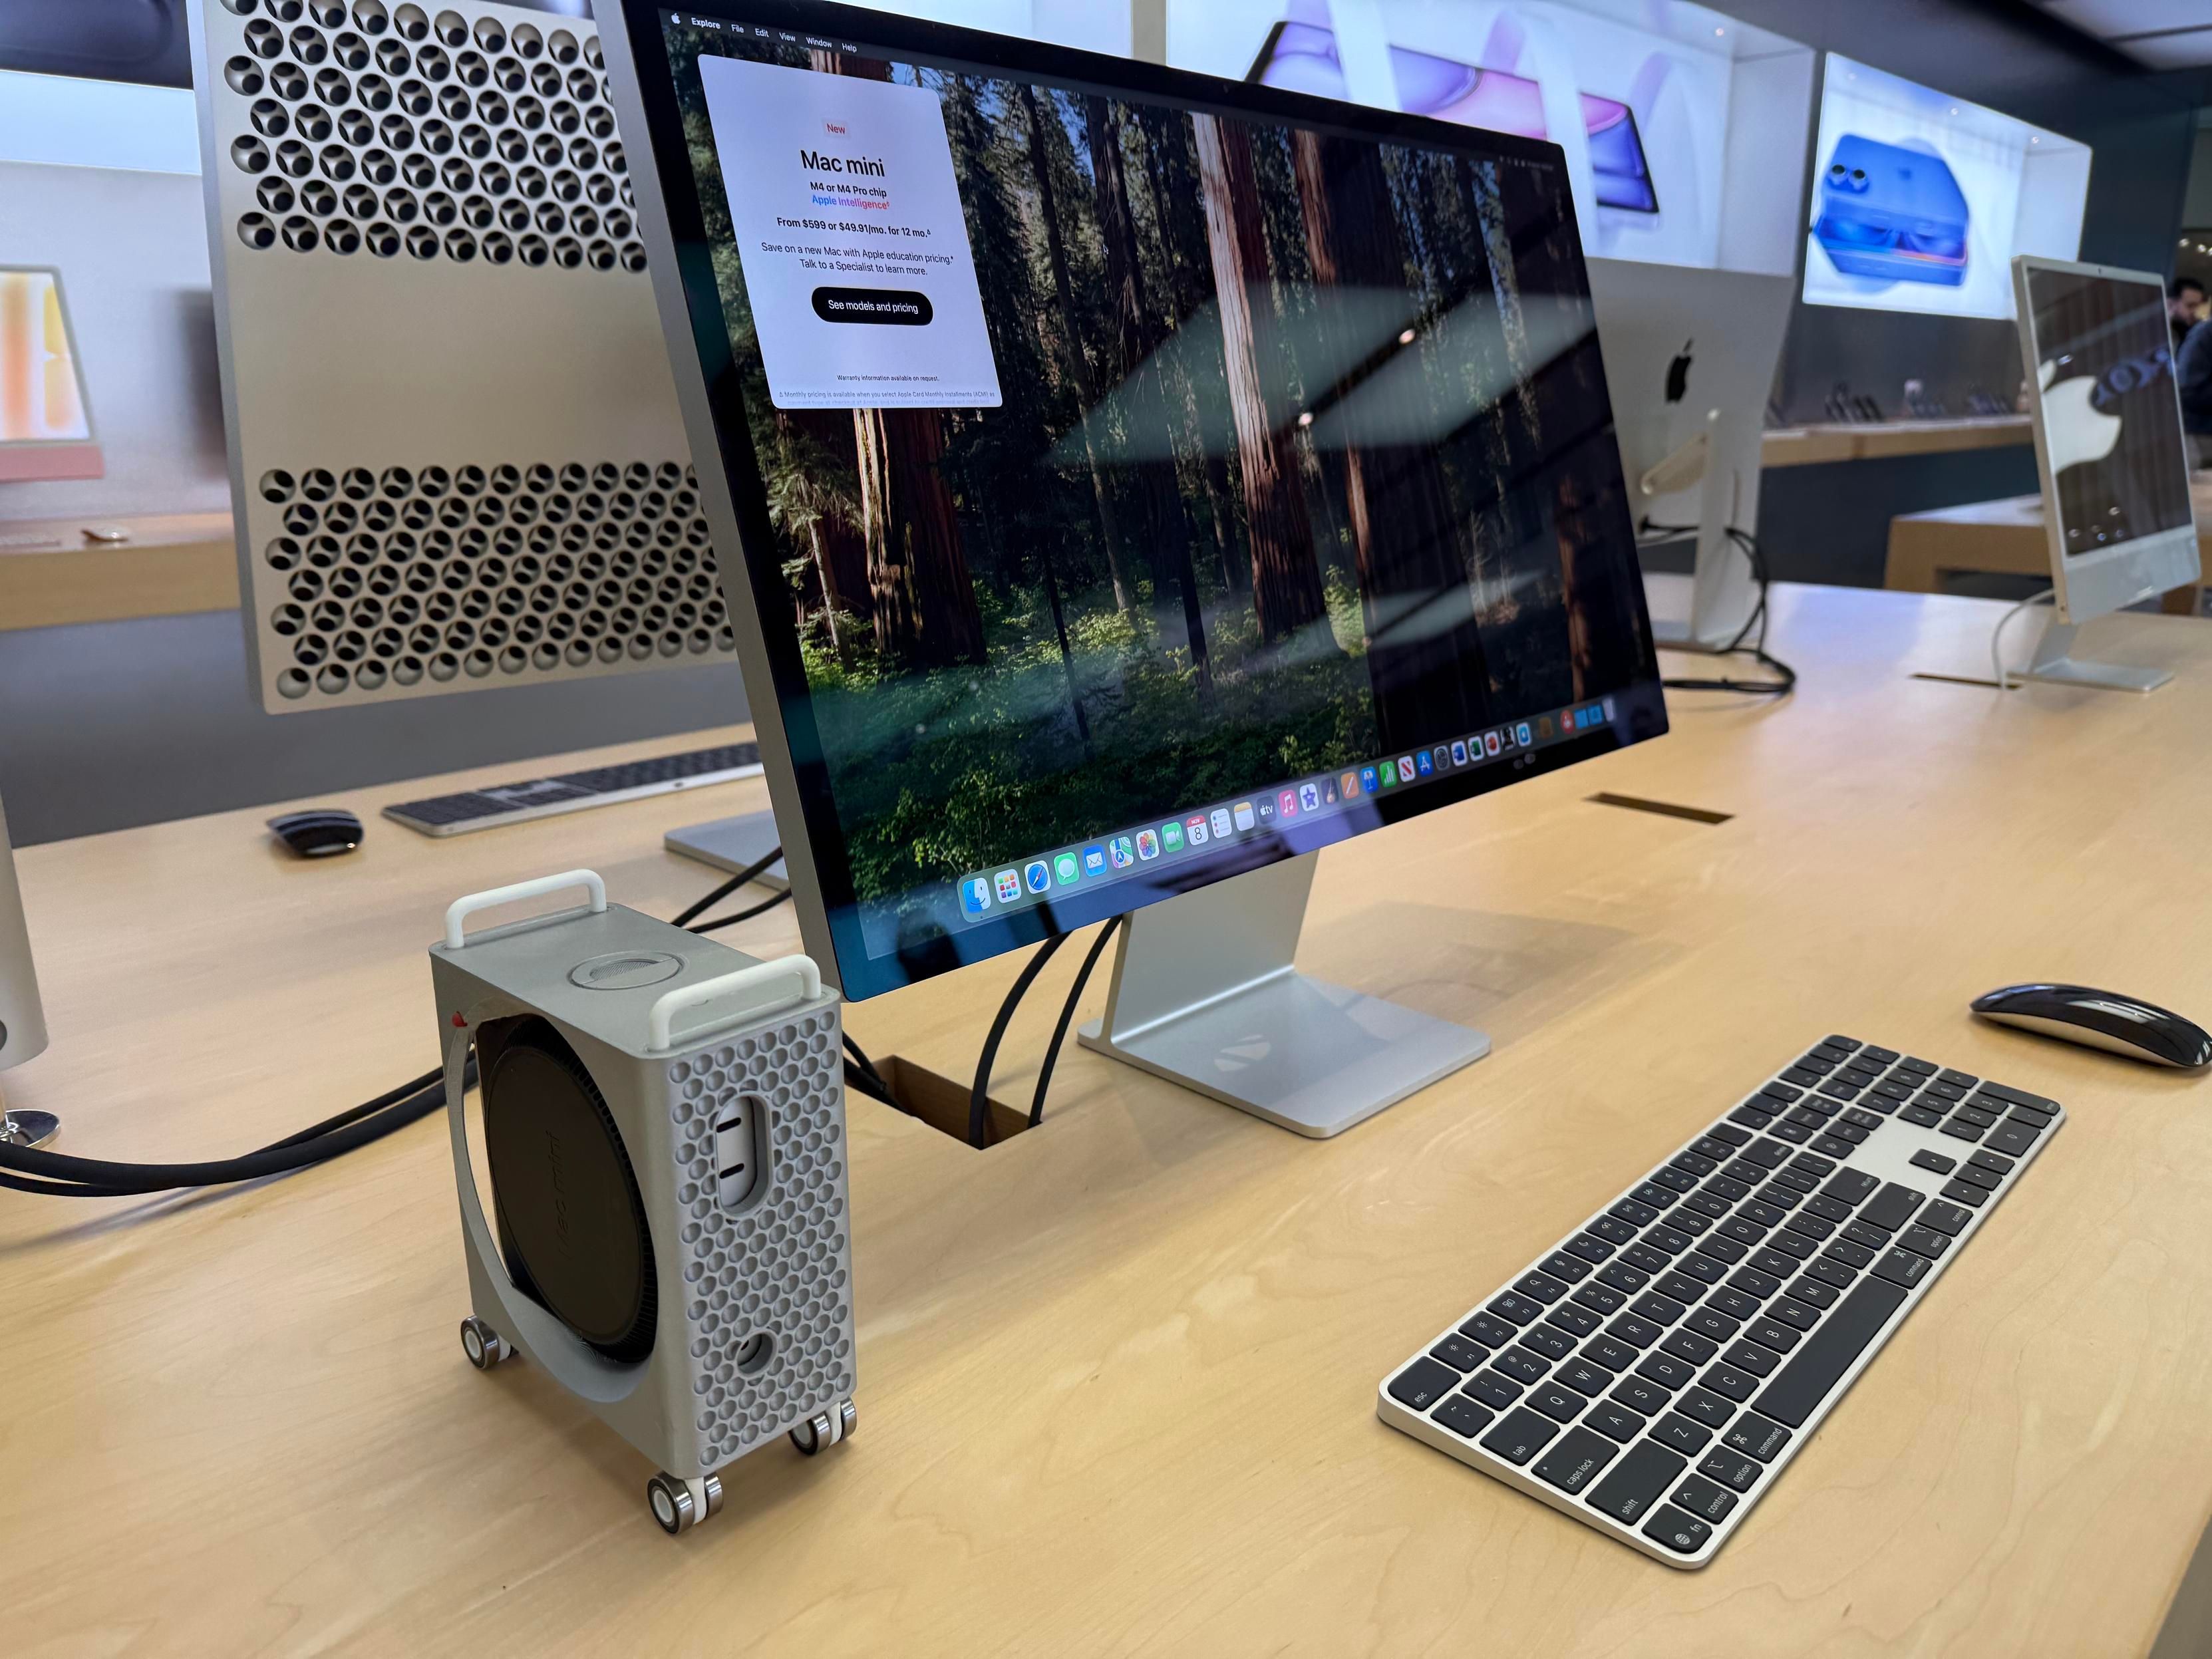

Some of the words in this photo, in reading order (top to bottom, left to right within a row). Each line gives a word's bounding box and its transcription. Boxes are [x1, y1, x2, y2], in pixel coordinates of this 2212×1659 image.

[691, 17, 720, 29] Explore
[731, 24, 744, 33] File
[755, 28, 769, 37] Edit
[779, 32, 796, 42] View
[806, 37, 832, 48] Window
[842, 43, 857, 53] Help
[827, 123, 845, 134] New
[800, 150, 842, 172] Mac
[846, 156, 885, 177] mini
[810, 181, 824, 192] M4
[837, 184, 851, 194] M4
[853, 186, 867, 196] Pro
[869, 188, 887, 199] chip
[812, 194, 837, 206] Apple
[777, 217, 800, 227] From
[802, 219, 826, 229] $599
[839, 222, 887, 235] $49.91/mo.
[888, 226, 899, 235] for
[901, 227, 911, 236] 12
[761, 242, 782, 252] Save
[824, 246, 842, 256] Mac
[843, 248, 861, 257] with
[862, 249, 885, 260] Apple
[886, 251, 924, 261] education
[799, 259, 817, 269] Talk
[818, 261, 827, 269] to
[836, 261, 874, 272] Specialist
[885, 263, 905, 274] learn
[906, 267, 928, 275] more.
[828, 299, 845, 309] See
[846, 301, 875, 311] models
[876, 301, 891, 311] and
[892, 303, 919, 315] pricing
[1194, 827, 1202, 840] 8
[1952, 1209, 1965, 1223] control
[1931, 1235, 1943, 1247] option
[1647, 1257, 1659, 1265] 7
[1906, 1258, 1925, 1277] command
[1805, 1286, 1819, 1296] M
[1726, 1298, 1740, 1307] H
[1786, 1308, 1800, 1317] N
[1603, 1347, 1617, 1356] E
[1682, 1341, 1694, 1350] F
[1523, 1364, 1536, 1373] 2
[1659, 1366, 1672, 1374] D
[1575, 1370, 1591, 1380] W
[1414, 1392, 1427, 1403] esc
[1550, 1396, 1565, 1405] Q
[1698, 1401, 1714, 1411] X
[1609, 1416, 1623, 1426] A
[1674, 1428, 1688, 1437] Z
[1758, 1427, 1782, 1455] command
[1512, 1445, 1526, 1455] tab
[1567, 1470, 1583, 1485] caps
[1577, 1459, 1594, 1471] lock
[1734, 1464, 1752, 1482] option
[1622, 1499, 1639, 1514] shift
[1707, 1491, 1728, 1514] control
